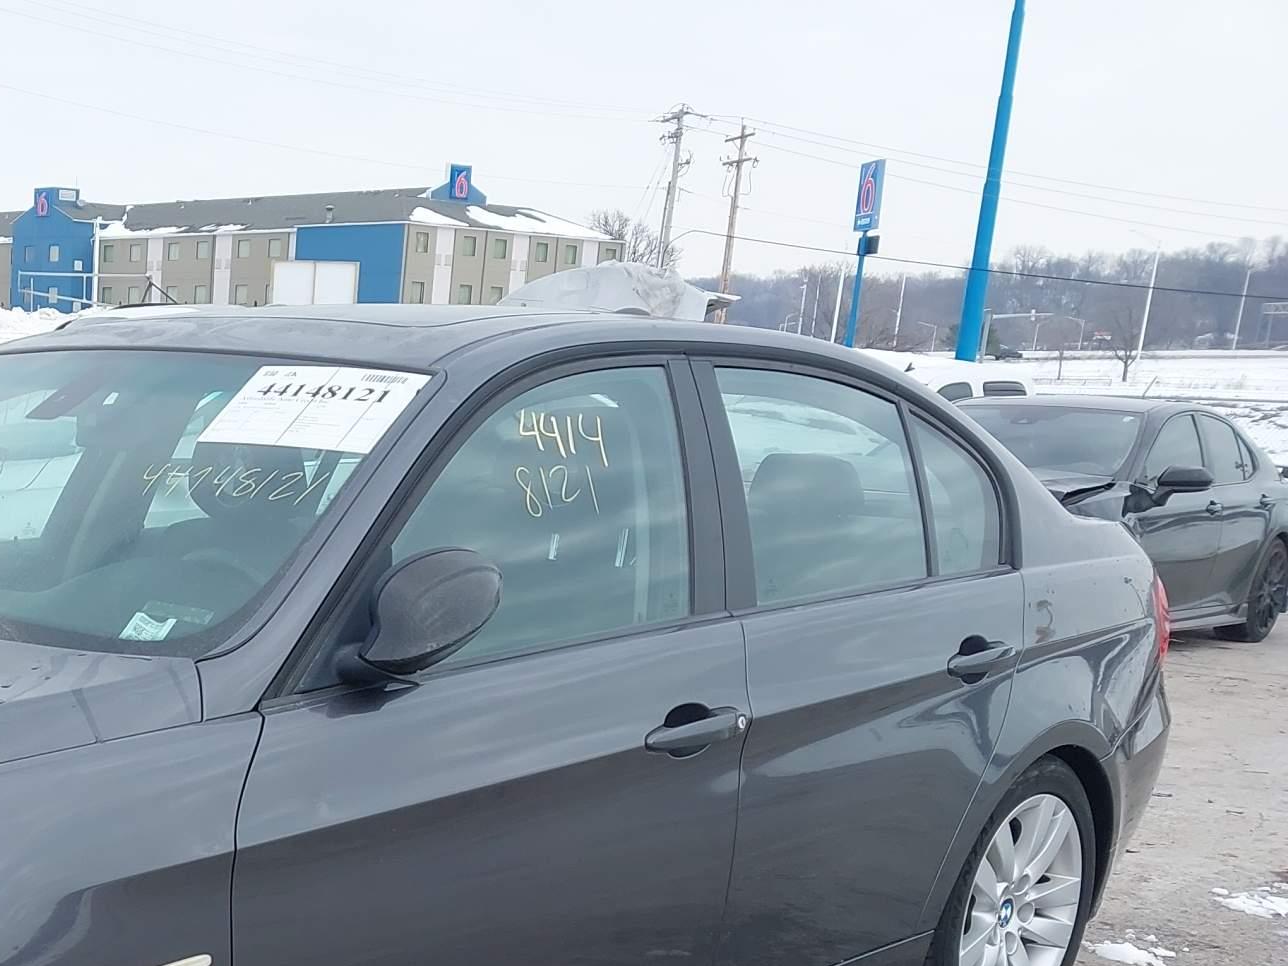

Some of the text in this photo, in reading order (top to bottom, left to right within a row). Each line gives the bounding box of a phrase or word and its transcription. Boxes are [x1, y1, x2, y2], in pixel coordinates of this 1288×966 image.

[455, 170, 468, 199] 6
[860, 163, 875, 214] 6
[257, 382, 391, 402] 44148121
[519, 408, 608, 467] 4414
[515, 465, 600, 517] 8121
